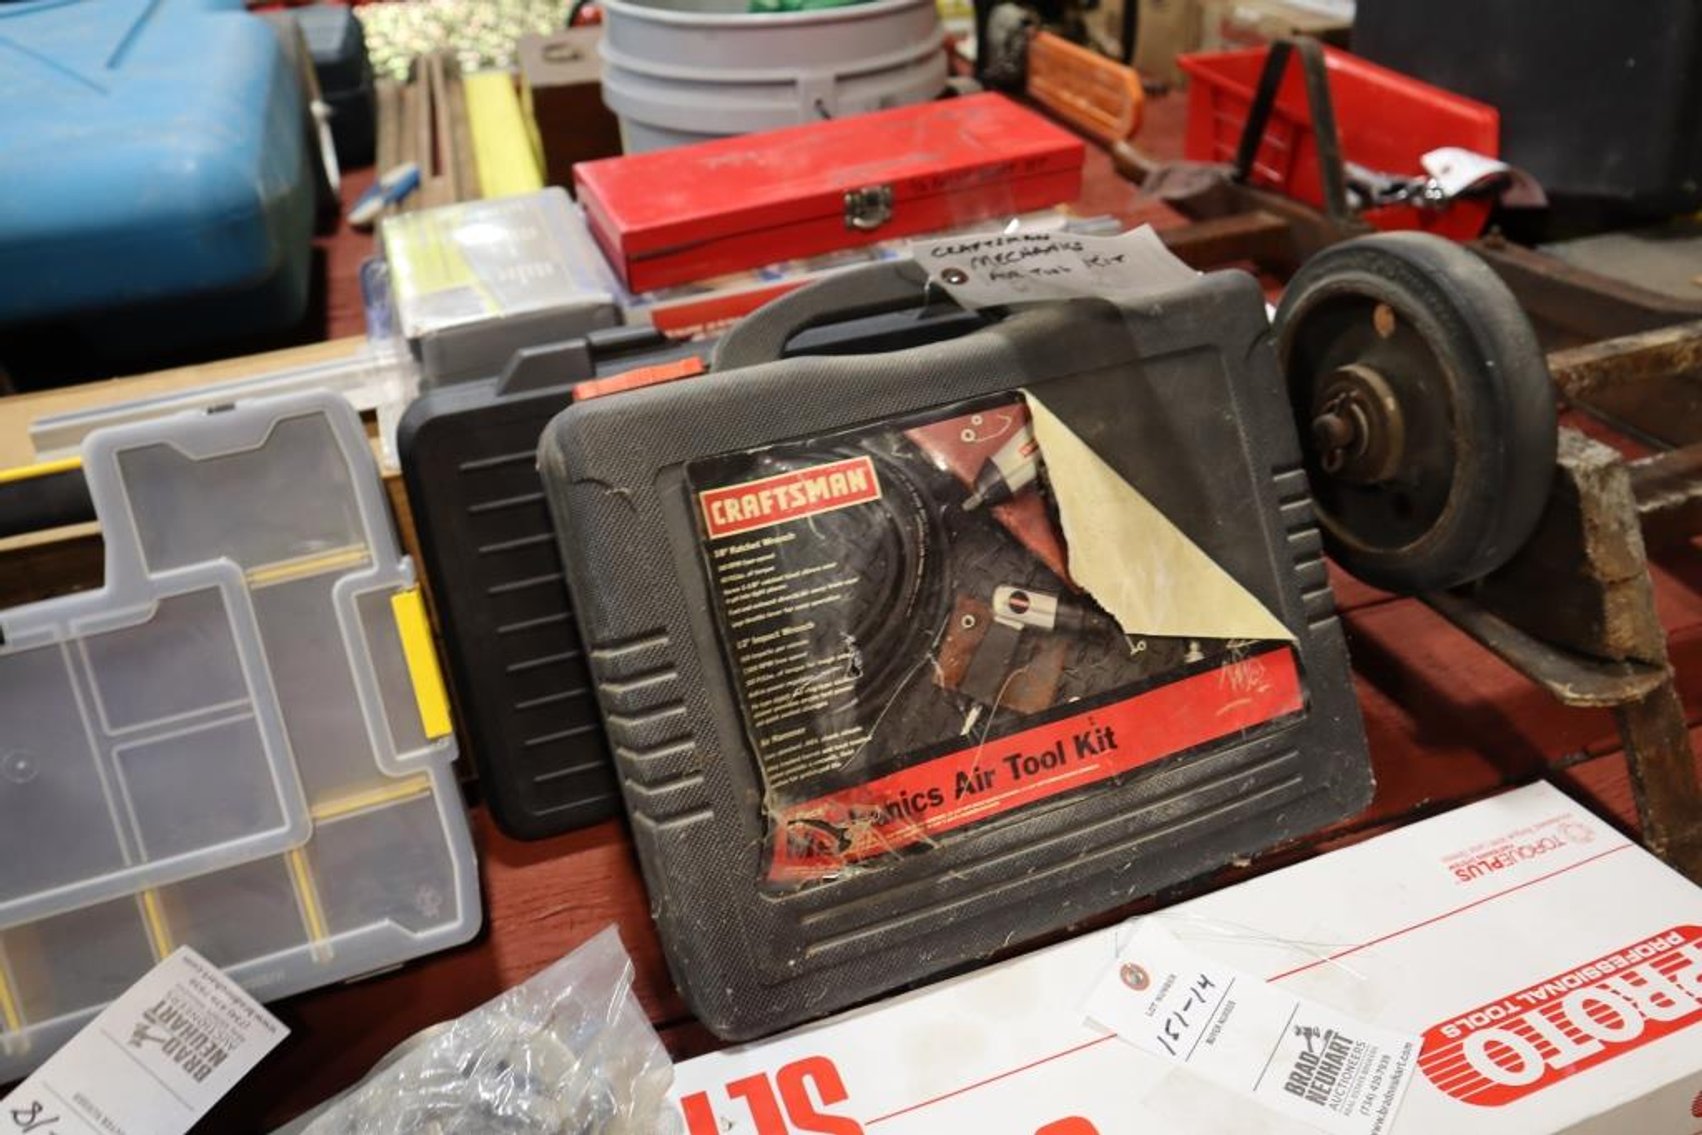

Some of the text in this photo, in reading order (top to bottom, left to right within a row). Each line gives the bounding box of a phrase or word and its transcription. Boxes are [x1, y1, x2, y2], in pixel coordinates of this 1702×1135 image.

[710, 468, 868, 526] CRAFTSMAN
[954, 766, 997, 800] Air
[1003, 740, 1067, 780] Tool
[1074, 726, 1119, 757] Kit
[1156, 973, 1215, 1056] 151-14
[1440, 930, 1686, 1039] PROFESSIONAL TOOLS
[142, 1000, 229, 1068] NEUHART
[161, 1036, 212, 1083] BRAD
[1305, 1031, 1354, 1106] NEUHART
[1284, 1050, 1320, 1097] BRAD
[1329, 1040, 1366, 1112] AUCTIONEERS
